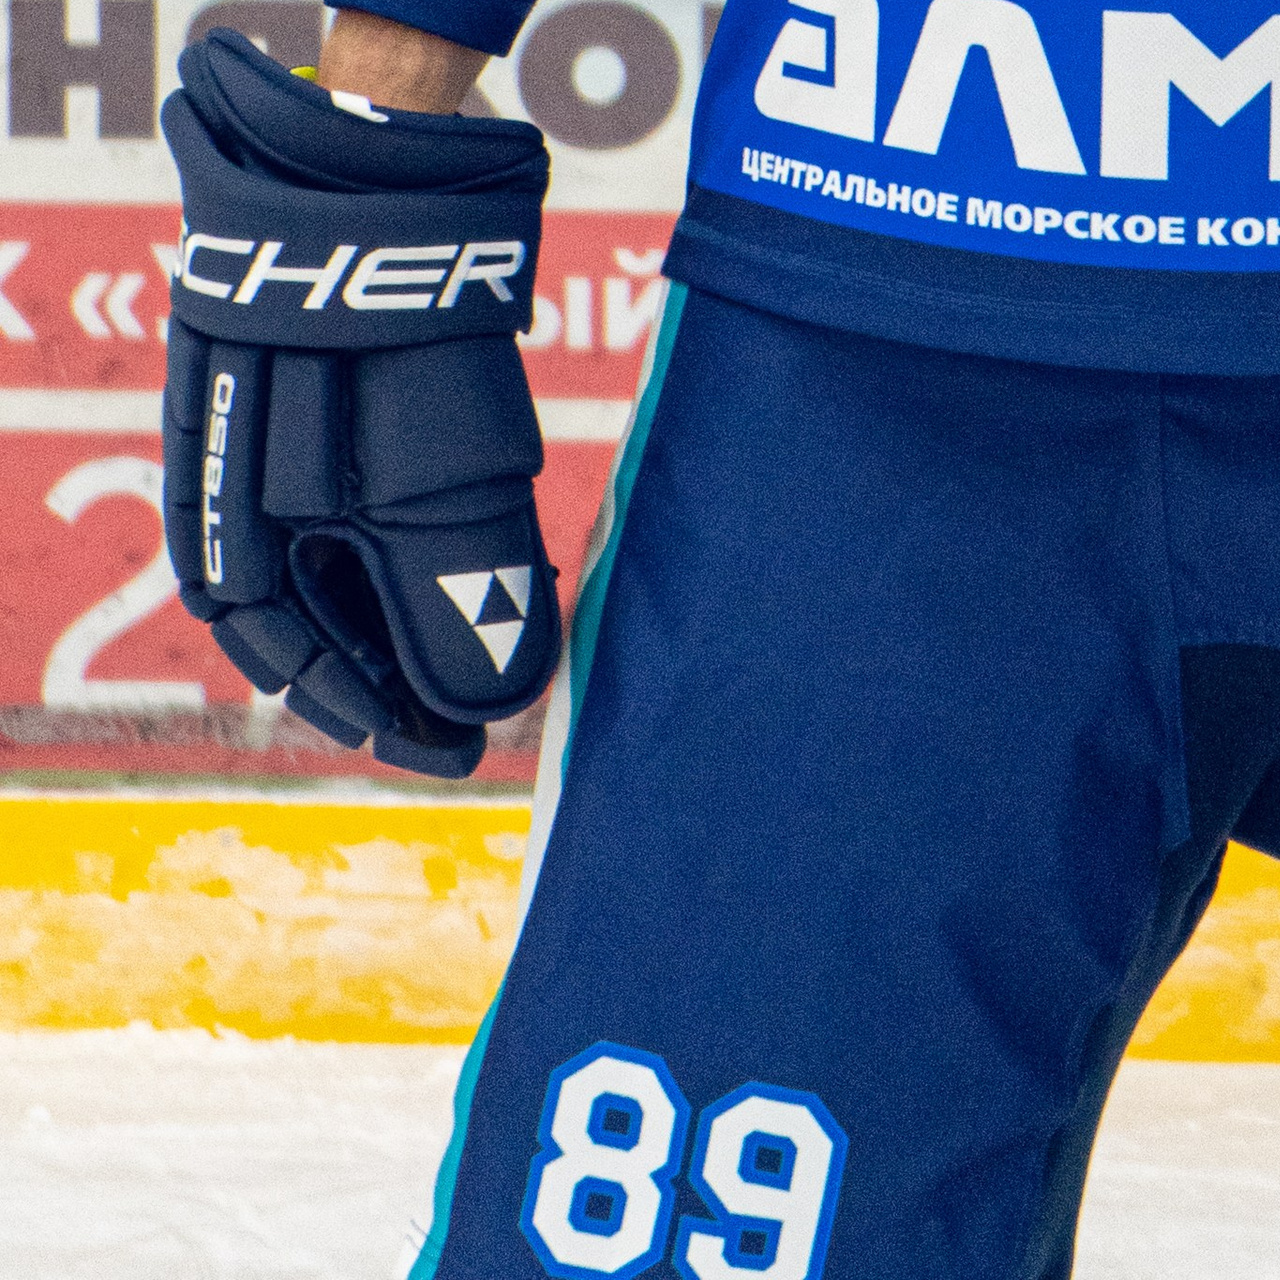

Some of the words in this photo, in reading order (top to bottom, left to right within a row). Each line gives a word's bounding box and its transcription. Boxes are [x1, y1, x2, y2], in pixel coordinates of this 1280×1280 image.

[174, 223, 524, 310] CHER
[742, 146, 958, 223] ЦЕНТРАЛЬНОЕ
[965, 197, 1186, 245] МОРСКОЕ
[203, 371, 236, 585] CT850
[524, 1045, 845, 1280] 89
